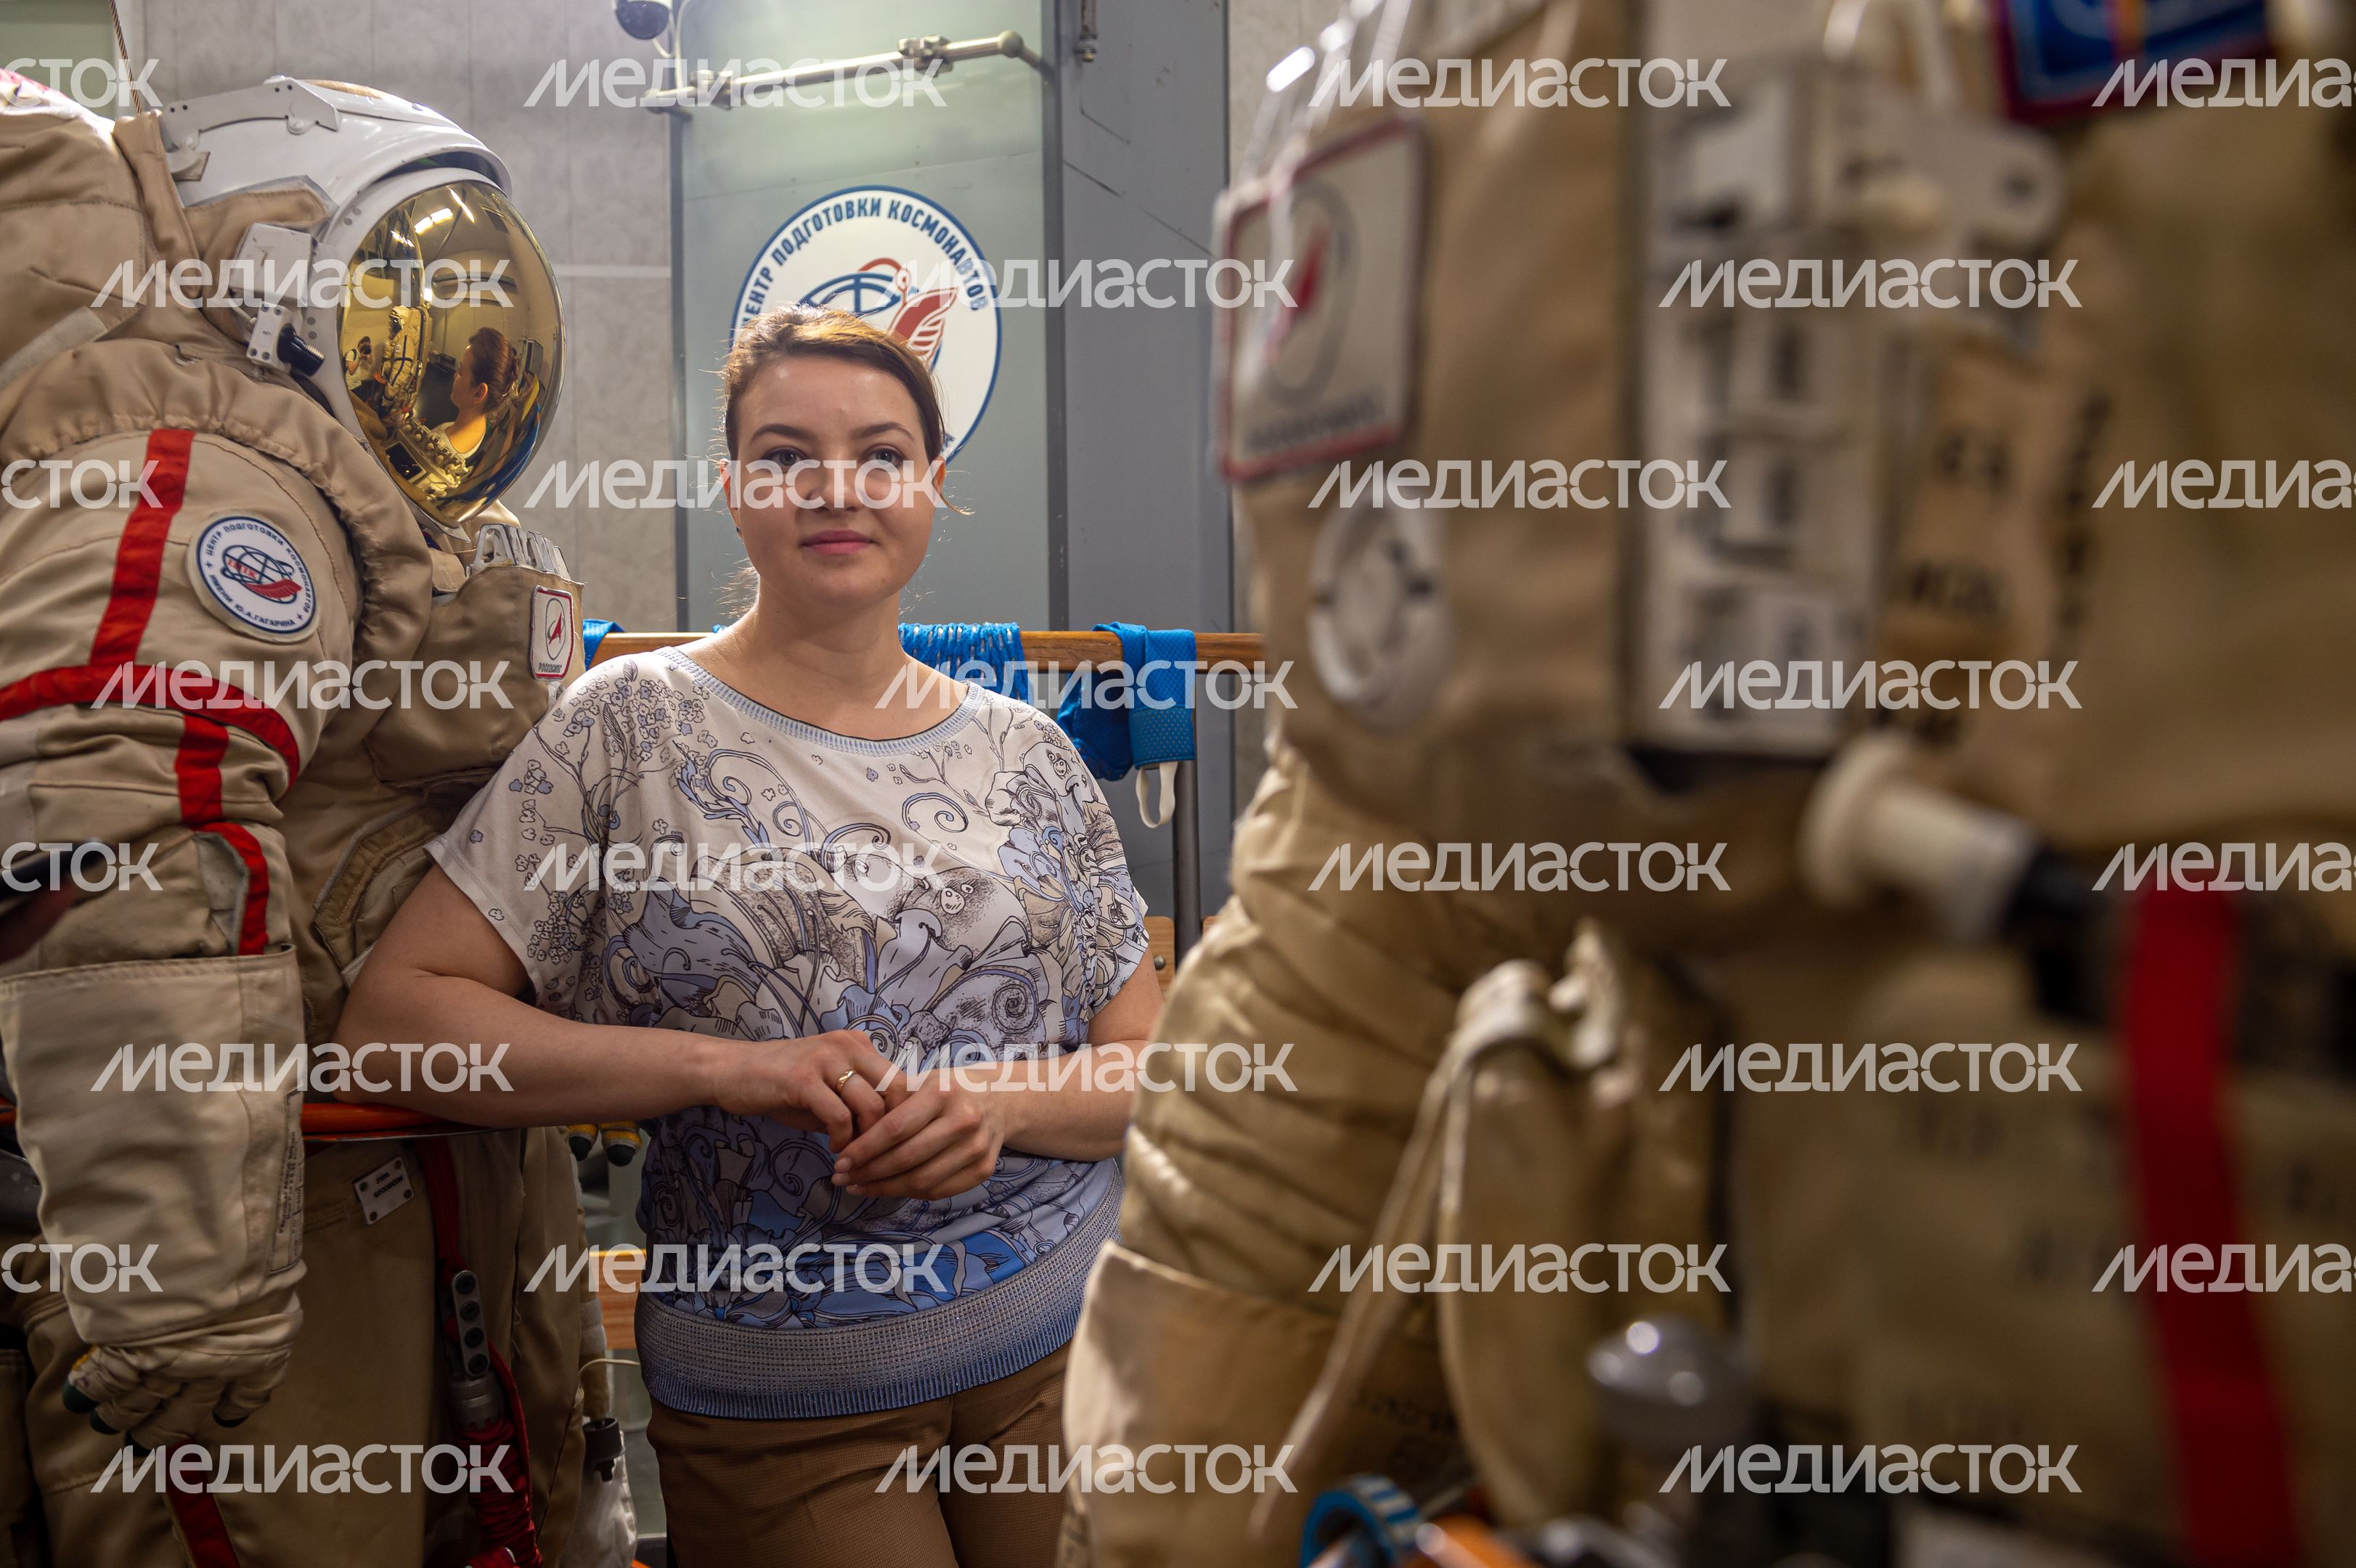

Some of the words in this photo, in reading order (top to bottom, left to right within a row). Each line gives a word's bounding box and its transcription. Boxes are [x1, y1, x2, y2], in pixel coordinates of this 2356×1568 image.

[771, 197, 883, 267] ПОДГОТОВКИ
[887, 199, 990, 311] КОСМОНАВТОВ
[205, 531, 223, 556] ЦЕНТР
[223, 522, 284, 547] ПОДГОТОВКИ
[286, 547, 312, 613] КОСМОНАВТОВ
[208, 575, 233, 603] ИМЕНИ
